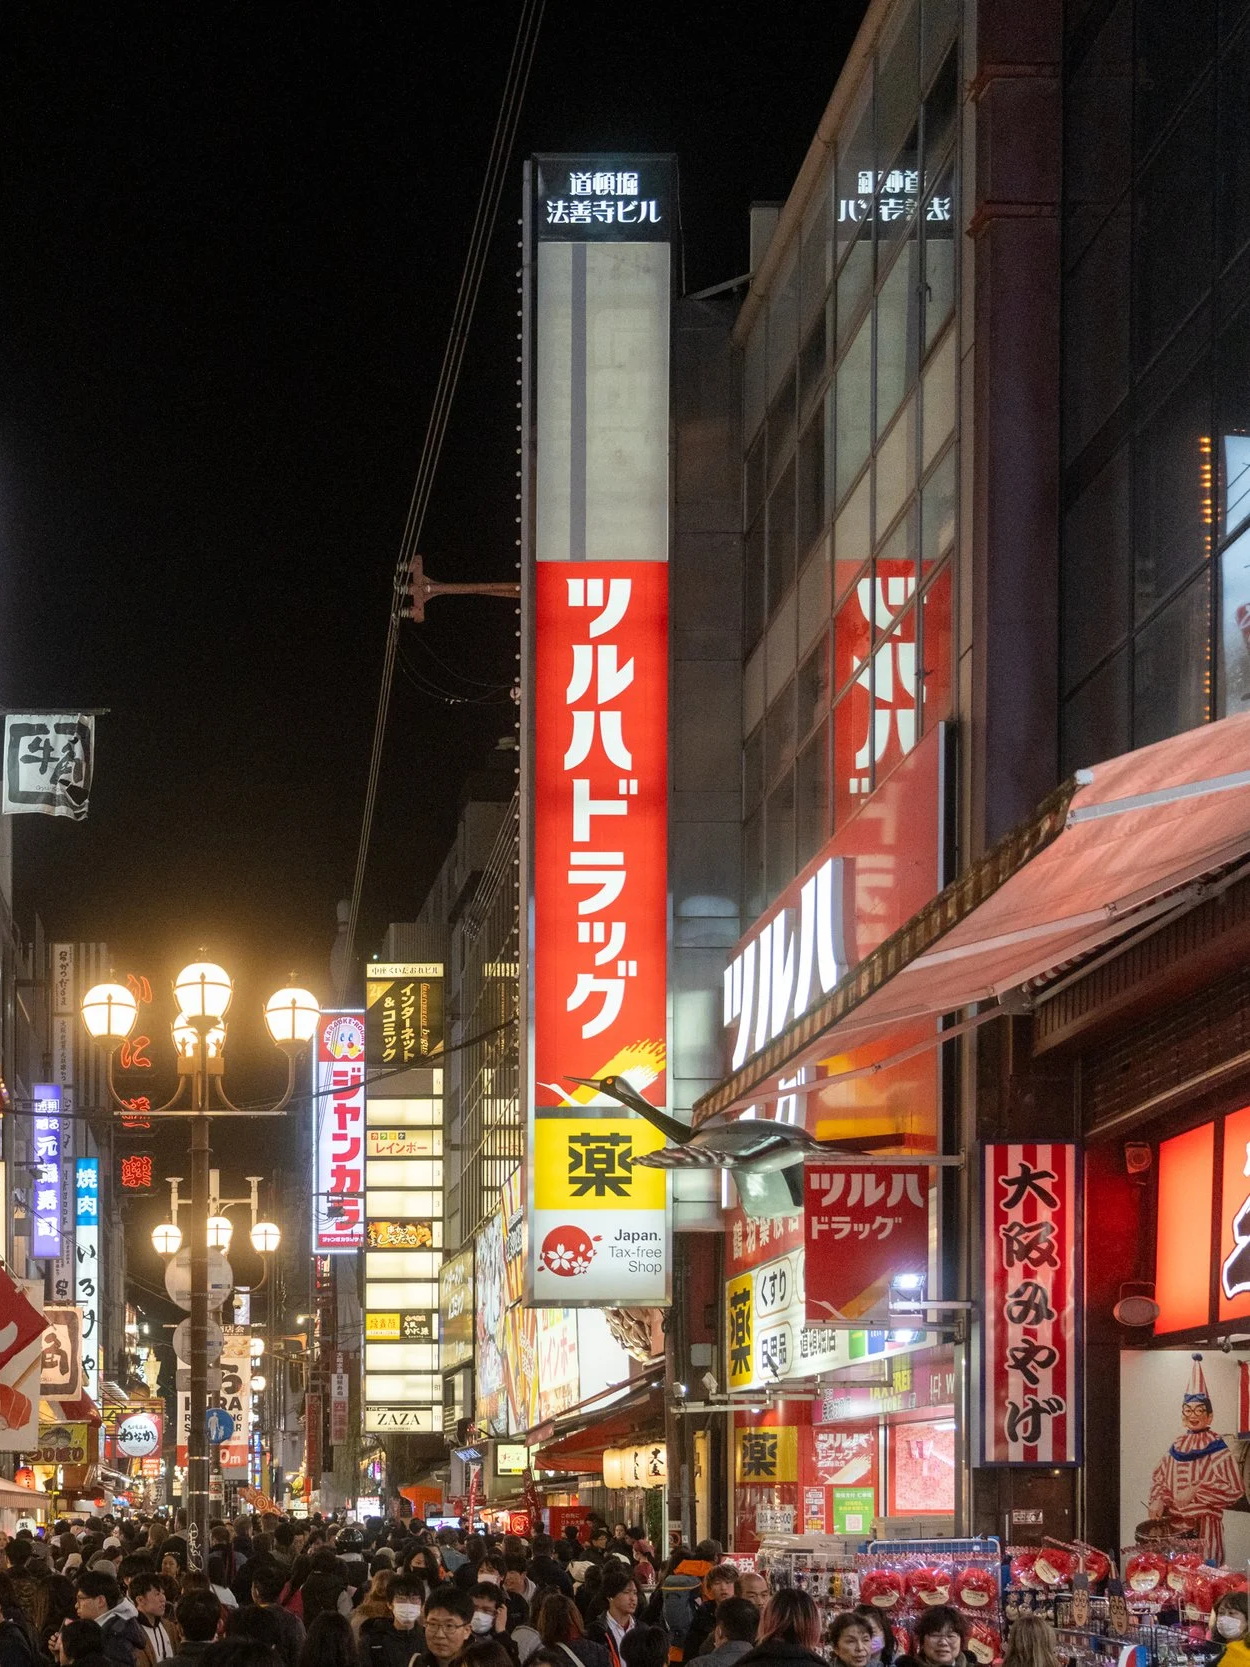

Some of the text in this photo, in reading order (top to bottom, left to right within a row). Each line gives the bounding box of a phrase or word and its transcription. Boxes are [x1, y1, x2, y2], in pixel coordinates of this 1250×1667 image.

[569, 171, 639, 197] 道頓堀
[546, 199, 662, 224] 法善寺ビル
[564, 578, 638, 1039] ツルハドラッグ
[723, 857, 838, 1072] ツルハ
[381, 996, 397, 1063] &コミック
[400, 982, 415, 1063] インターネット
[330, 1067, 362, 1231] ジャンカラ
[375, 1142, 428, 1154] レインボー
[567, 1132, 636, 1197] 薬
[76, 1168, 98, 1216] 焼肉
[810, 1172, 925, 1208] ツルハ
[614, 1229, 662, 1243] Japan.
[811, 1216, 903, 1240] ドラッグ
[608, 1246, 662, 1259] Tax-free
[628, 1260, 663, 1276] Shop
[760, 1268, 787, 1307] くすり
[999, 1161, 1068, 1447] 大阪みやげ
[729, 1288, 751, 1376] 薬
[761, 1333, 787, 1368] 日用品
[377, 1413, 422, 1426] ZAZA
[742, 1432, 778, 1477] 薬
